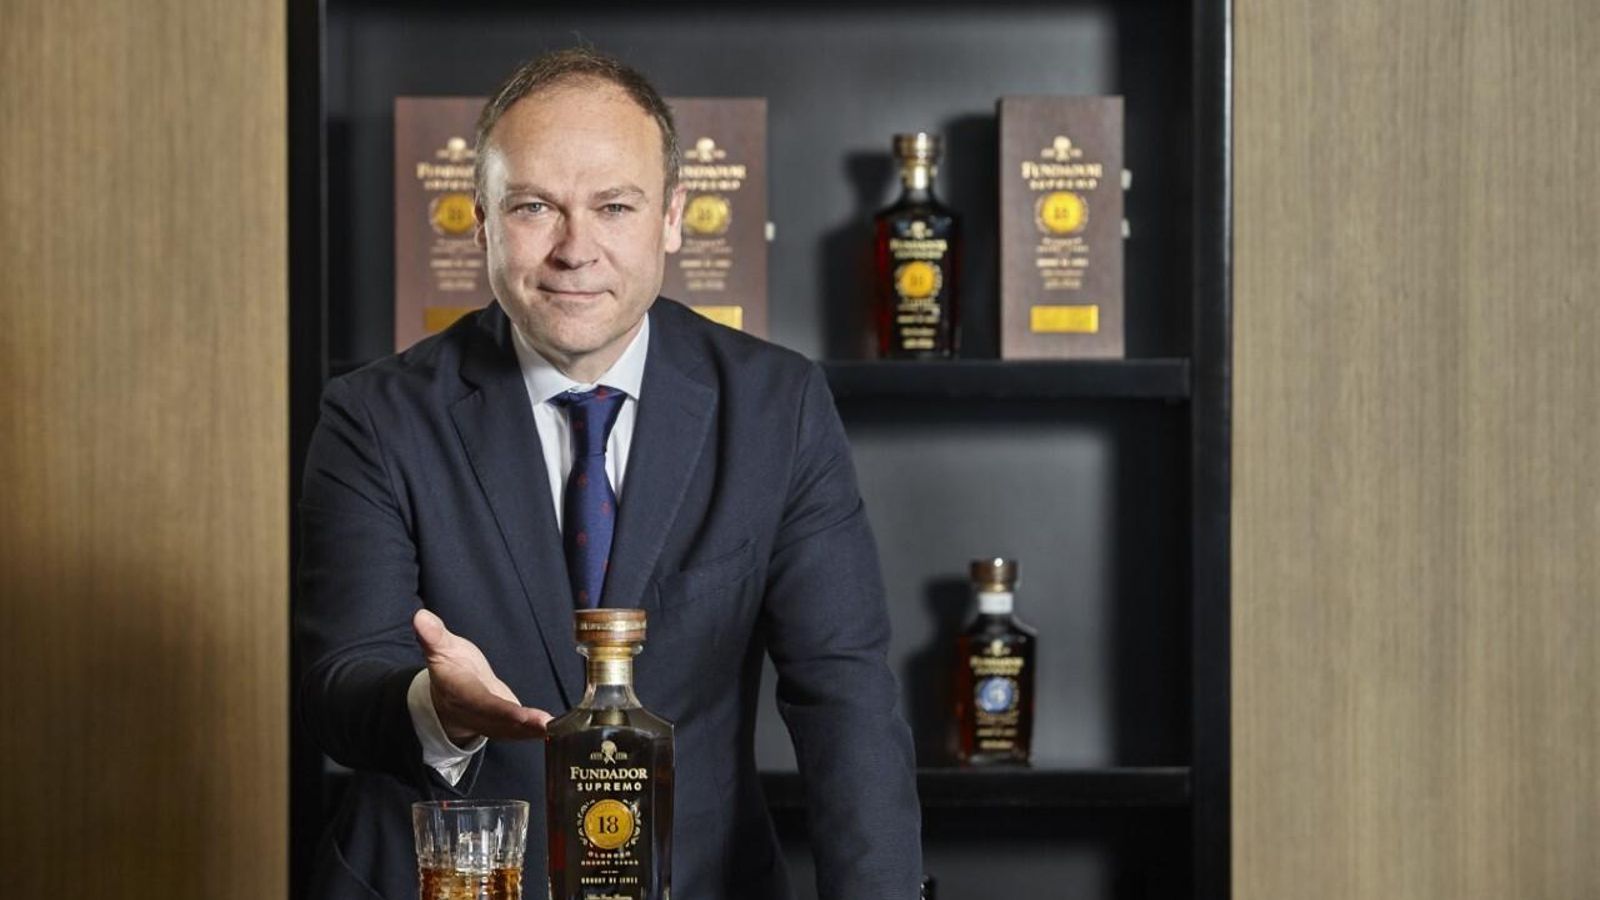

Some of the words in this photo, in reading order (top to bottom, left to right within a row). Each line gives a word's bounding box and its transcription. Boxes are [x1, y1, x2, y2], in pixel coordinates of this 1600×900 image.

[570, 766, 648, 780] FUNDADOR
[577, 782, 642, 791] SUPREMO
[598, 816, 619, 834] 18
